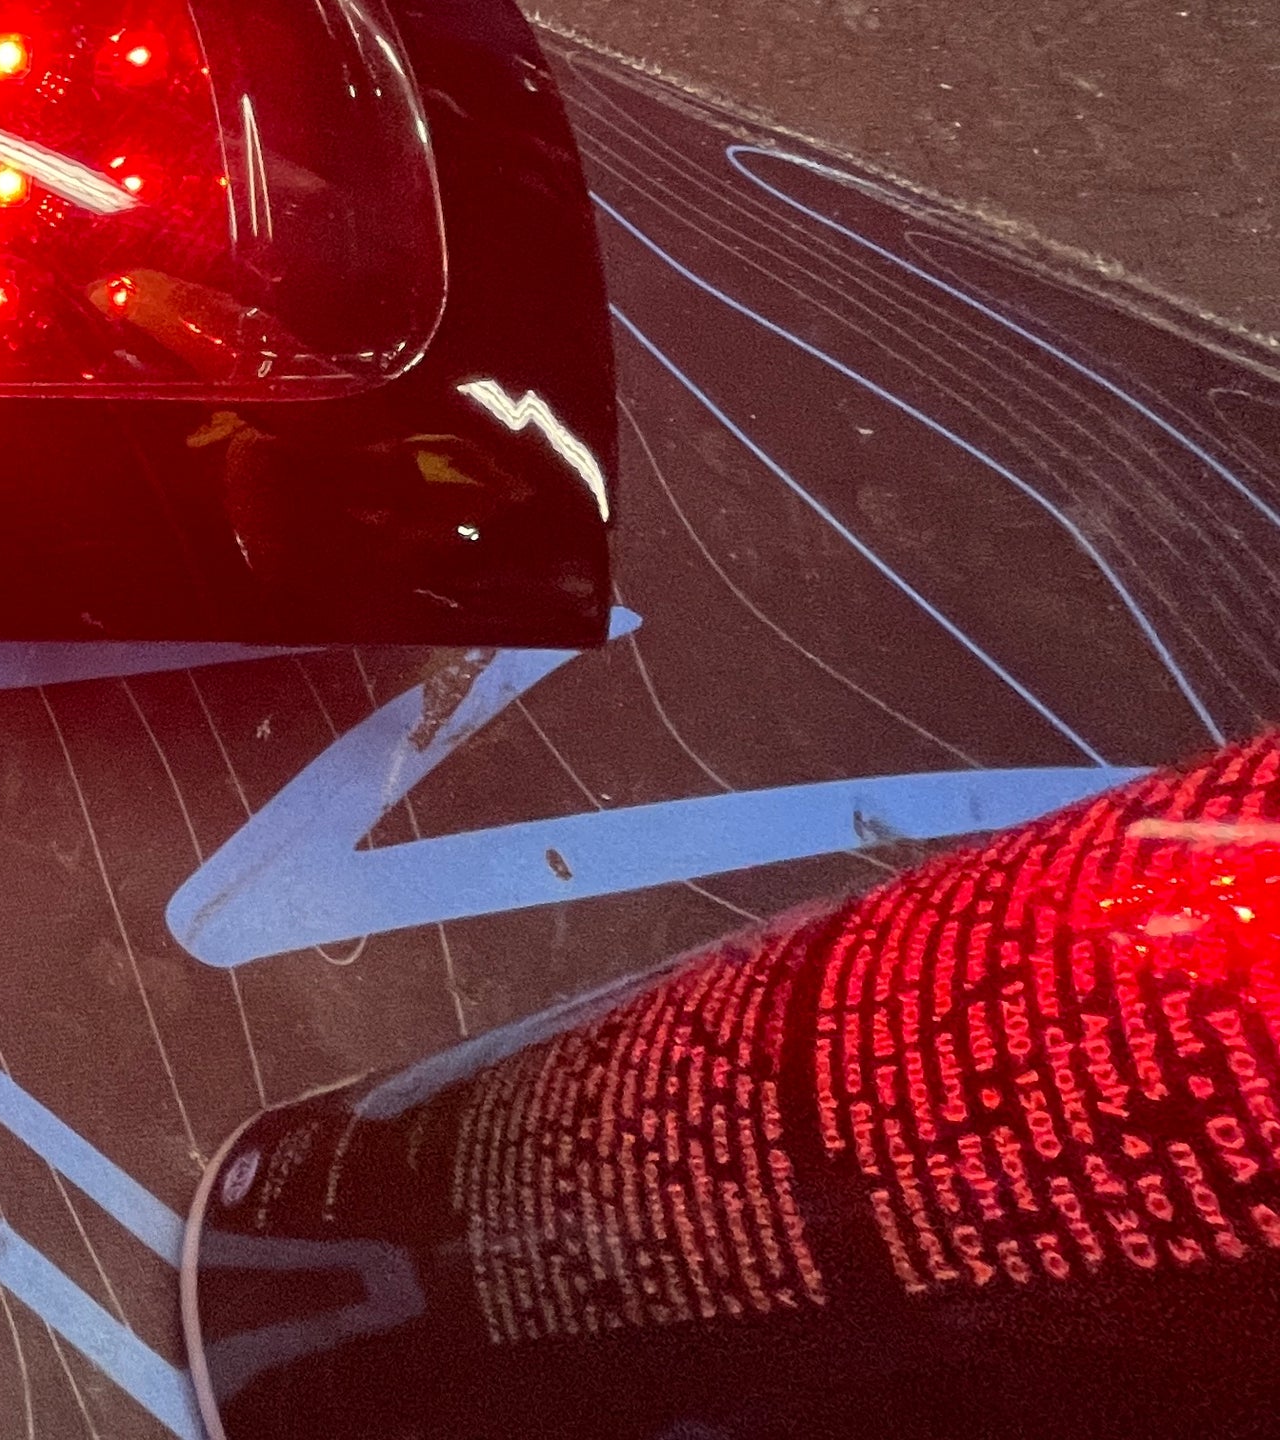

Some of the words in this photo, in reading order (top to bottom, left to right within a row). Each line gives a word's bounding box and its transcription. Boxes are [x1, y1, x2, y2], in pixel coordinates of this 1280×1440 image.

[1080, 1014, 1130, 1118] Apply
[1161, 991, 1205, 1057] but
[1044, 1026, 1096, 1146] choice
